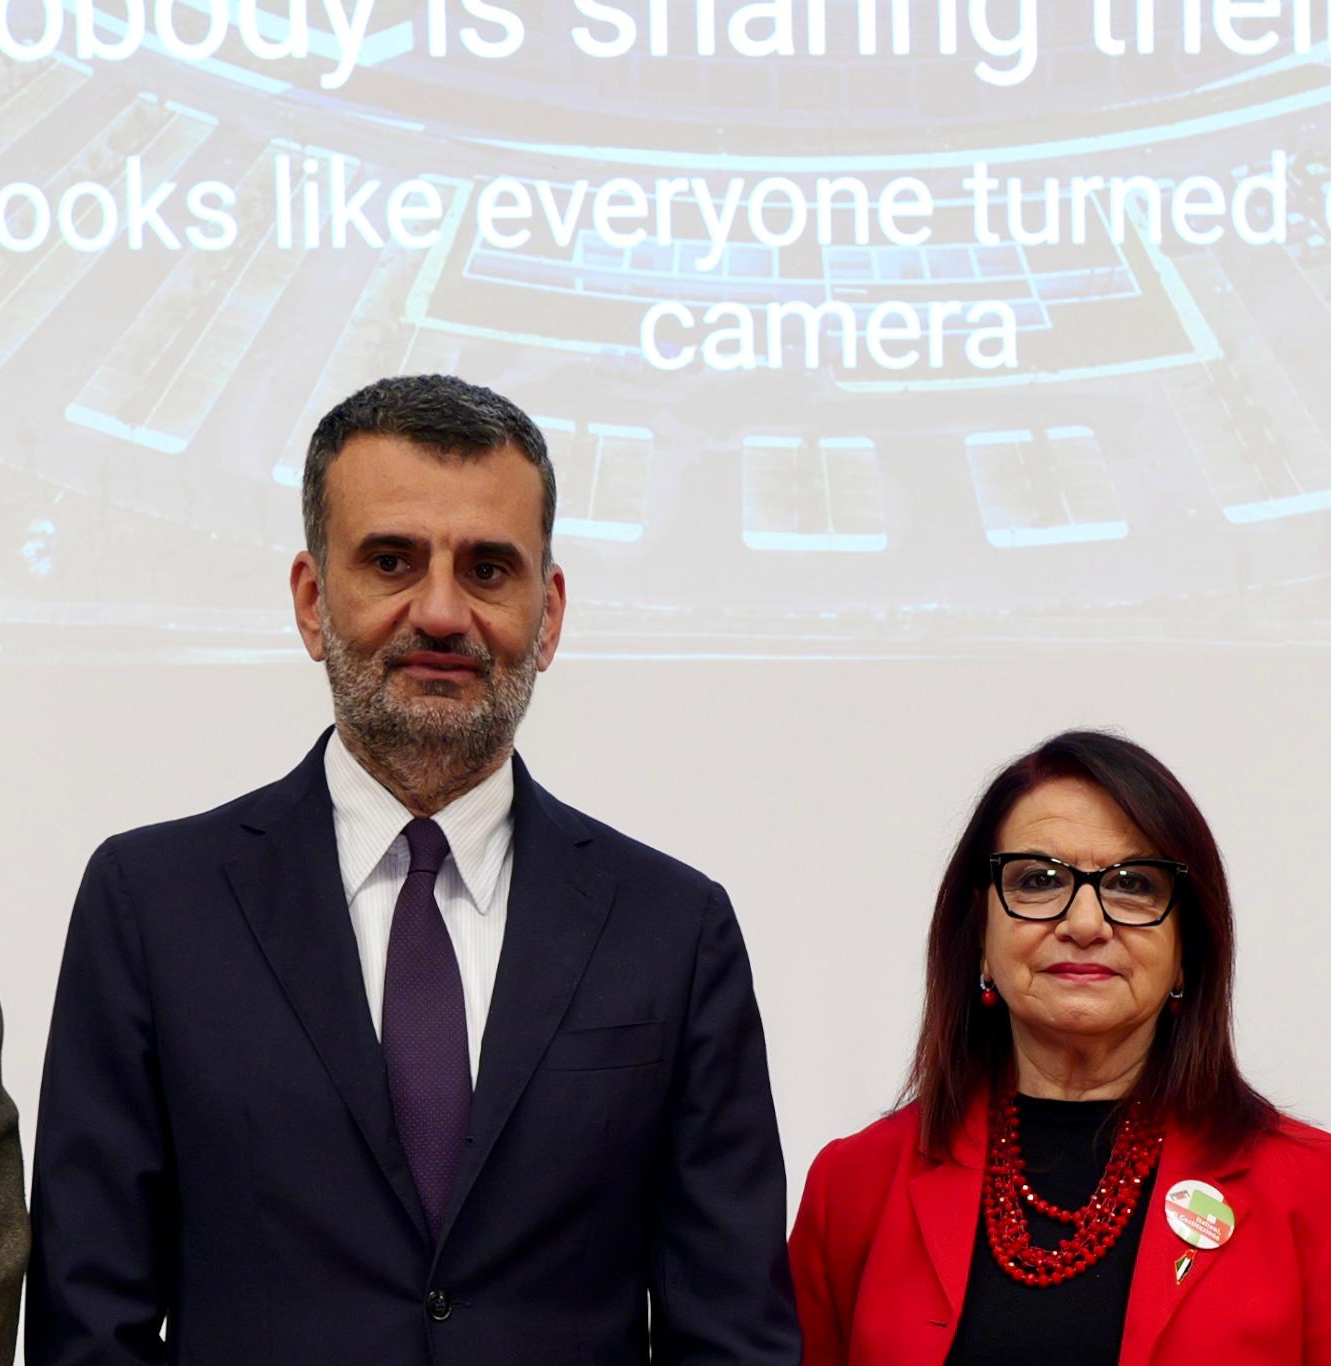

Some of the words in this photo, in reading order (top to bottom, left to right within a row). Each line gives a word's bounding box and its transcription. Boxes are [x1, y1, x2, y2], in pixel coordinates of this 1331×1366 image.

[429, 0, 525, 58] is
[571, 0, 1039, 87] sharing
[275, 155, 444, 251] like
[477, 169, 934, 273] everyone
[971, 150, 1289, 246] turned
[639, 296, 1019, 370] camera
